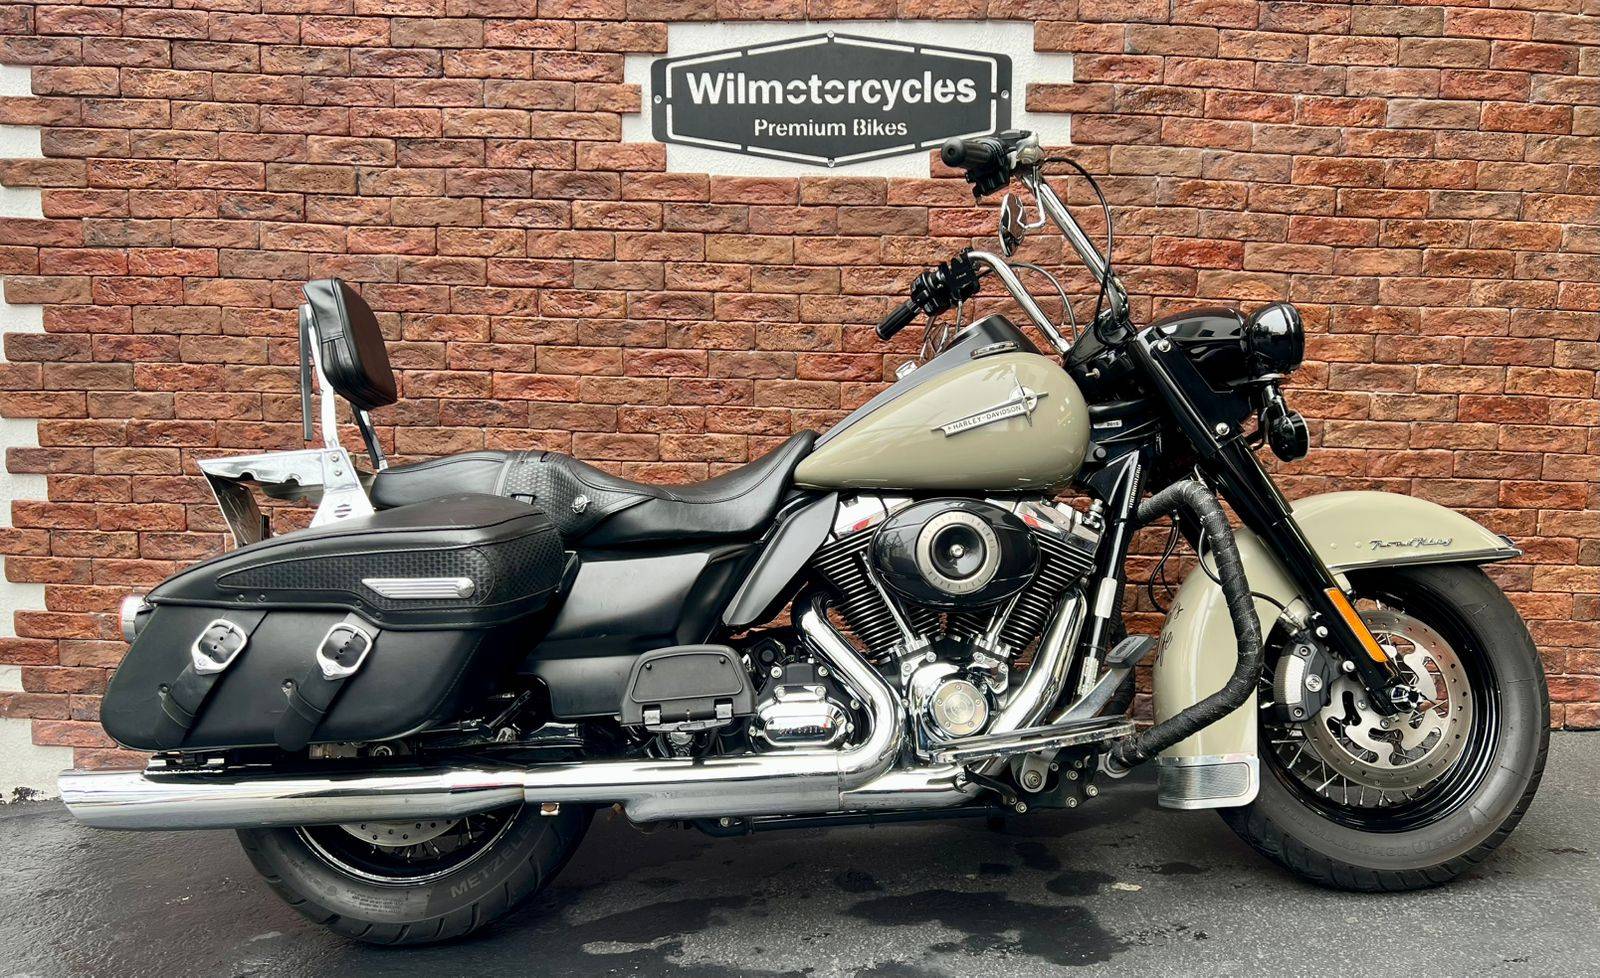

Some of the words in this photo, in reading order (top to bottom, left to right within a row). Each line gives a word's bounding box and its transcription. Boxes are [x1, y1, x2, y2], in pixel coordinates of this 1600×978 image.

[686, 71, 977, 111] Wilmotorcycles
[754, 119, 846, 137] Premium
[853, 118, 908, 136] Bikes
